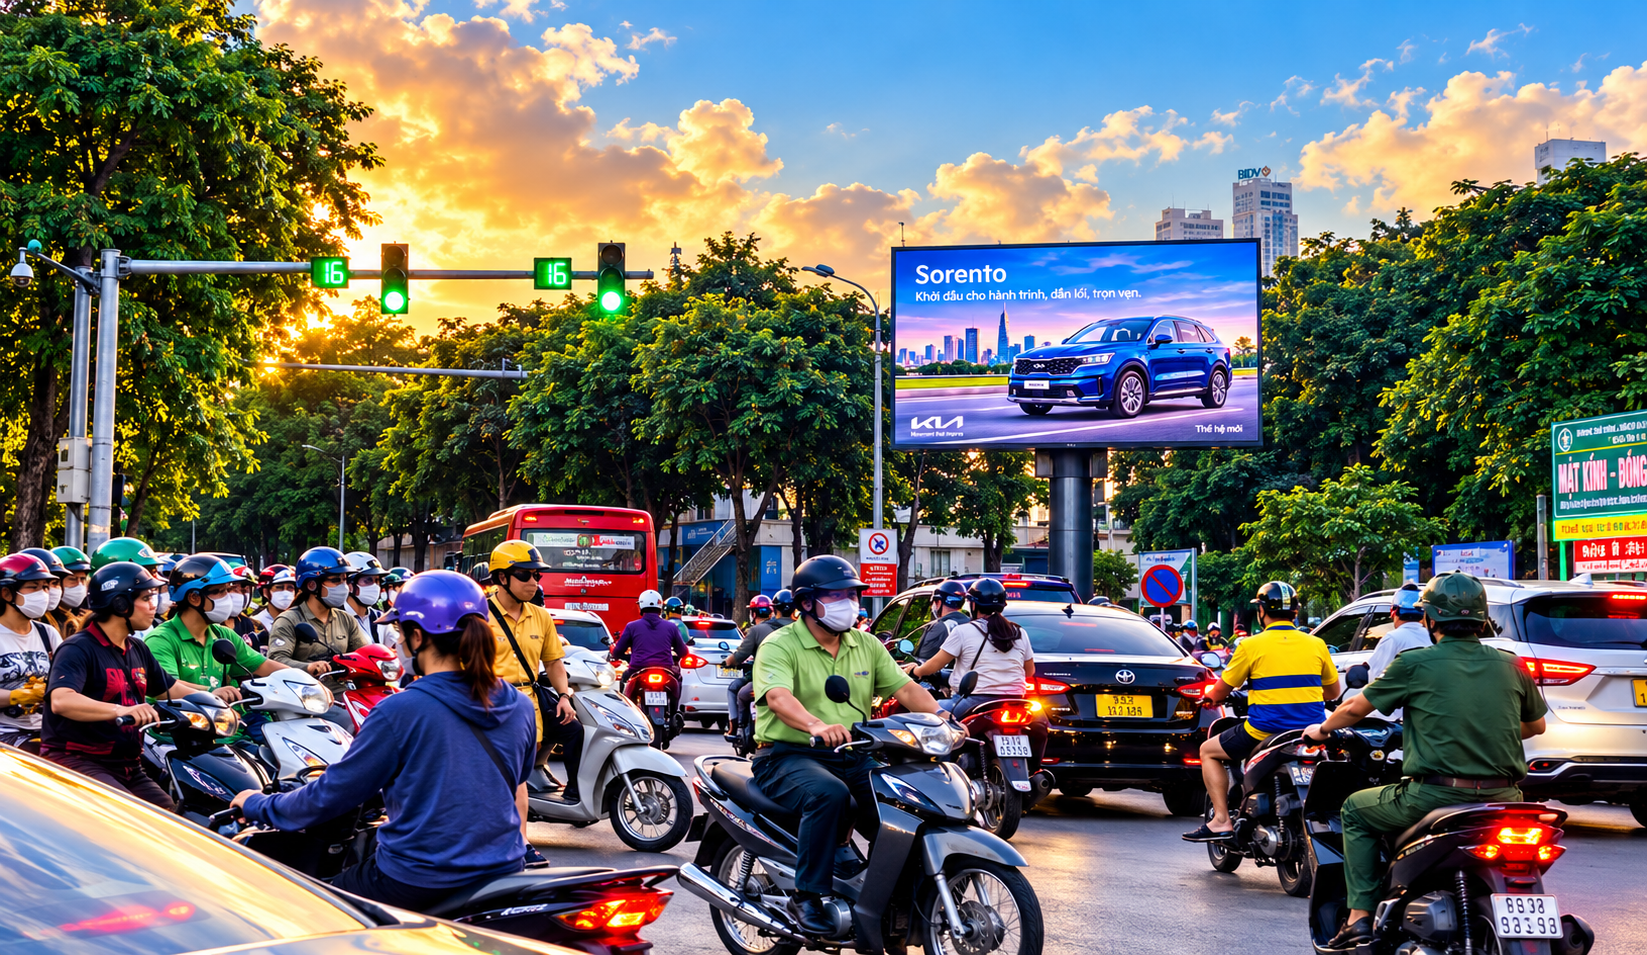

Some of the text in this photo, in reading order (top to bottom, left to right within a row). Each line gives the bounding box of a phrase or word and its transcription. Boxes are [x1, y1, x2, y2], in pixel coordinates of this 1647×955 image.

[1238, 167, 1261, 179] BIDV
[325, 261, 344, 284] 16
[548, 262, 567, 285] 16
[915, 264, 1007, 285] Sorento
[965, 290, 987, 301] cho
[910, 415, 964, 430] KIA
